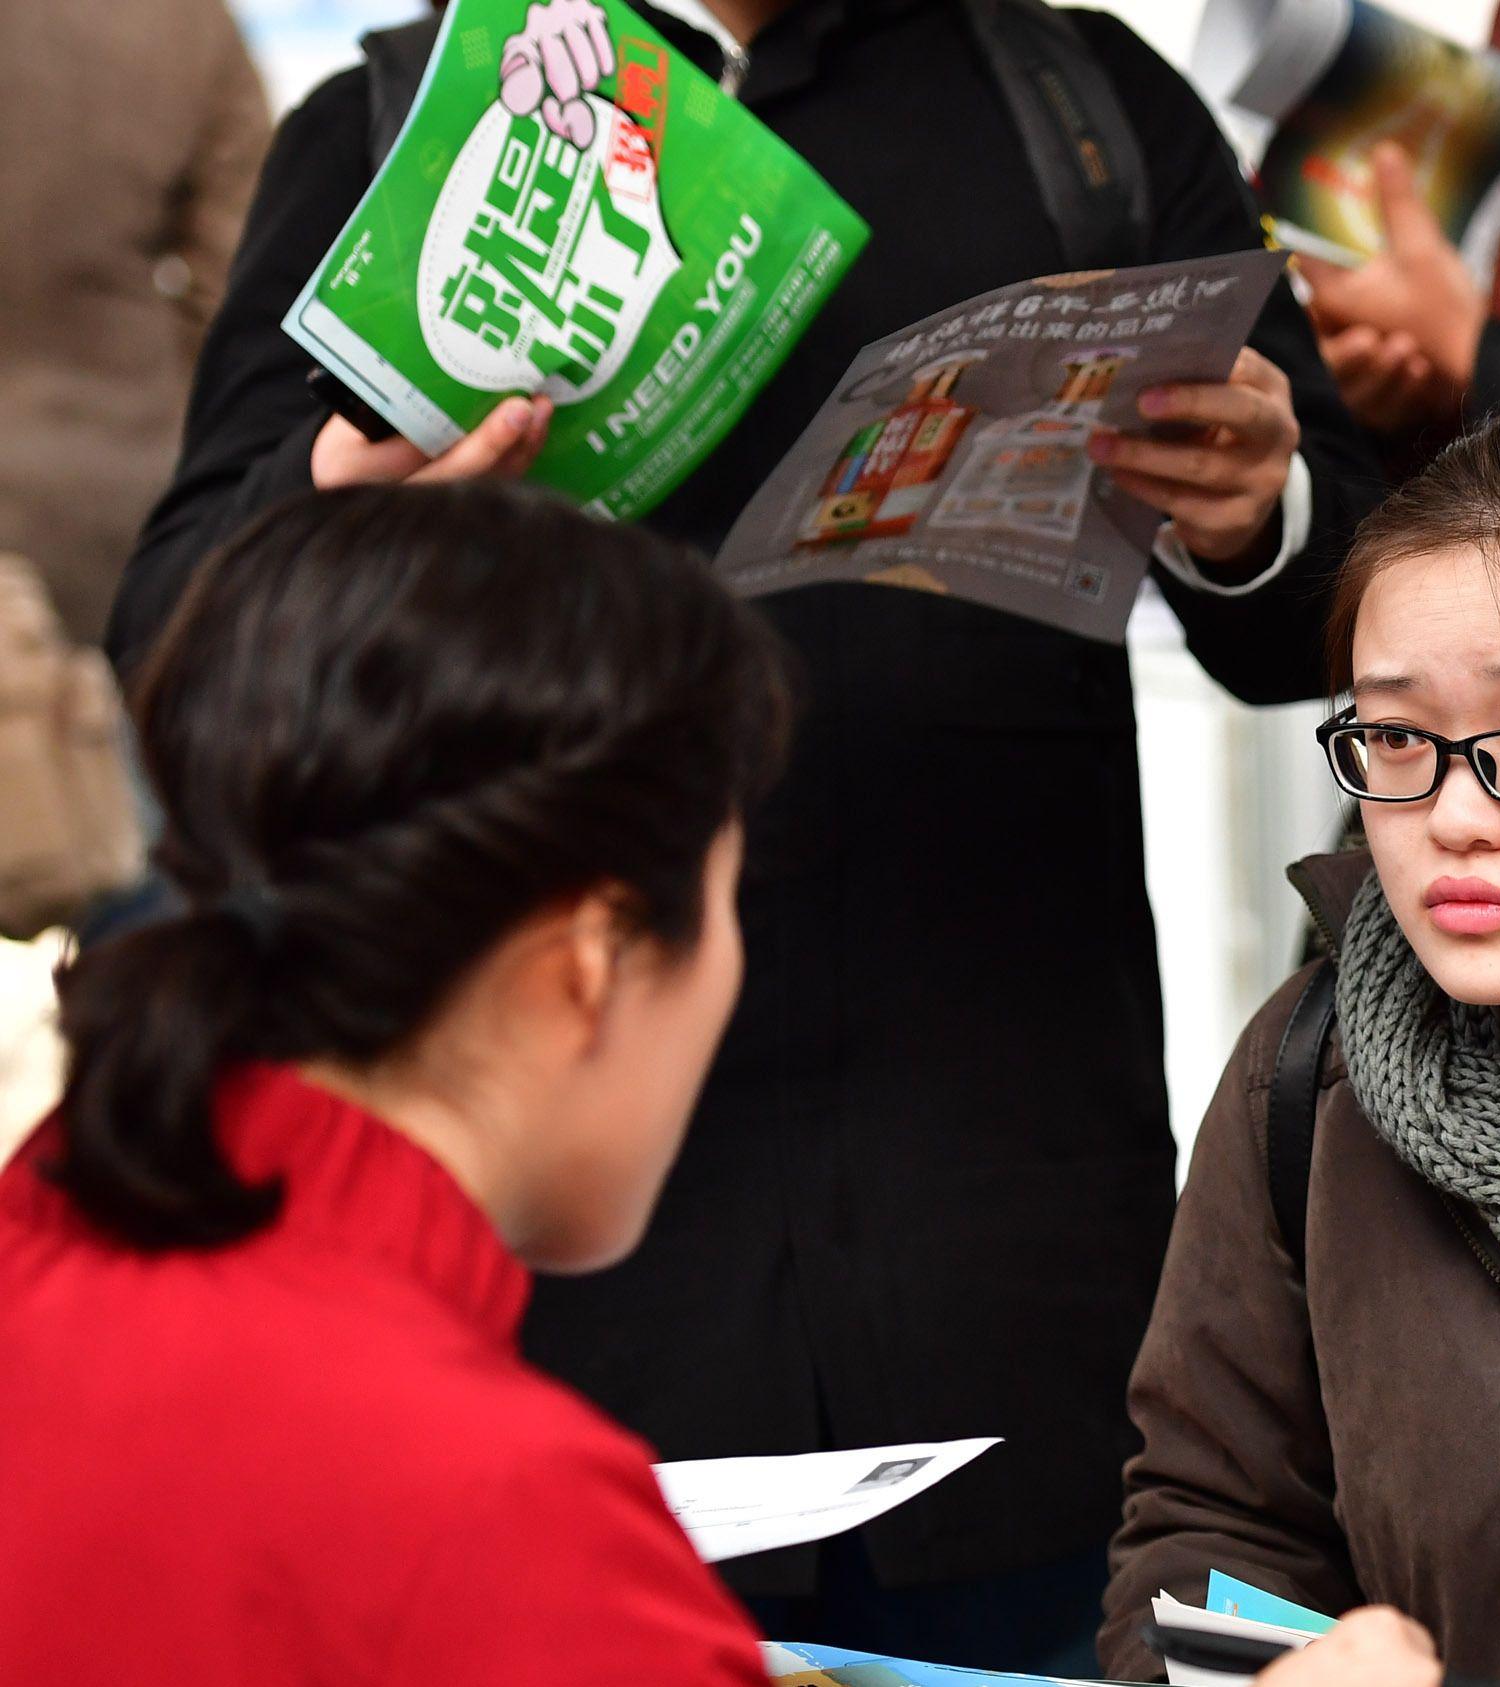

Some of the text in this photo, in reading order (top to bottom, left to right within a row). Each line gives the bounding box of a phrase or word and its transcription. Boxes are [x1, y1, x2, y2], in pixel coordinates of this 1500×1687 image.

[439, 114, 585, 351] 就是
[527, 165, 652, 388] 你了
[586, 430, 606, 455] I
[605, 322, 702, 438] NEED
[695, 213, 763, 315] YOU
